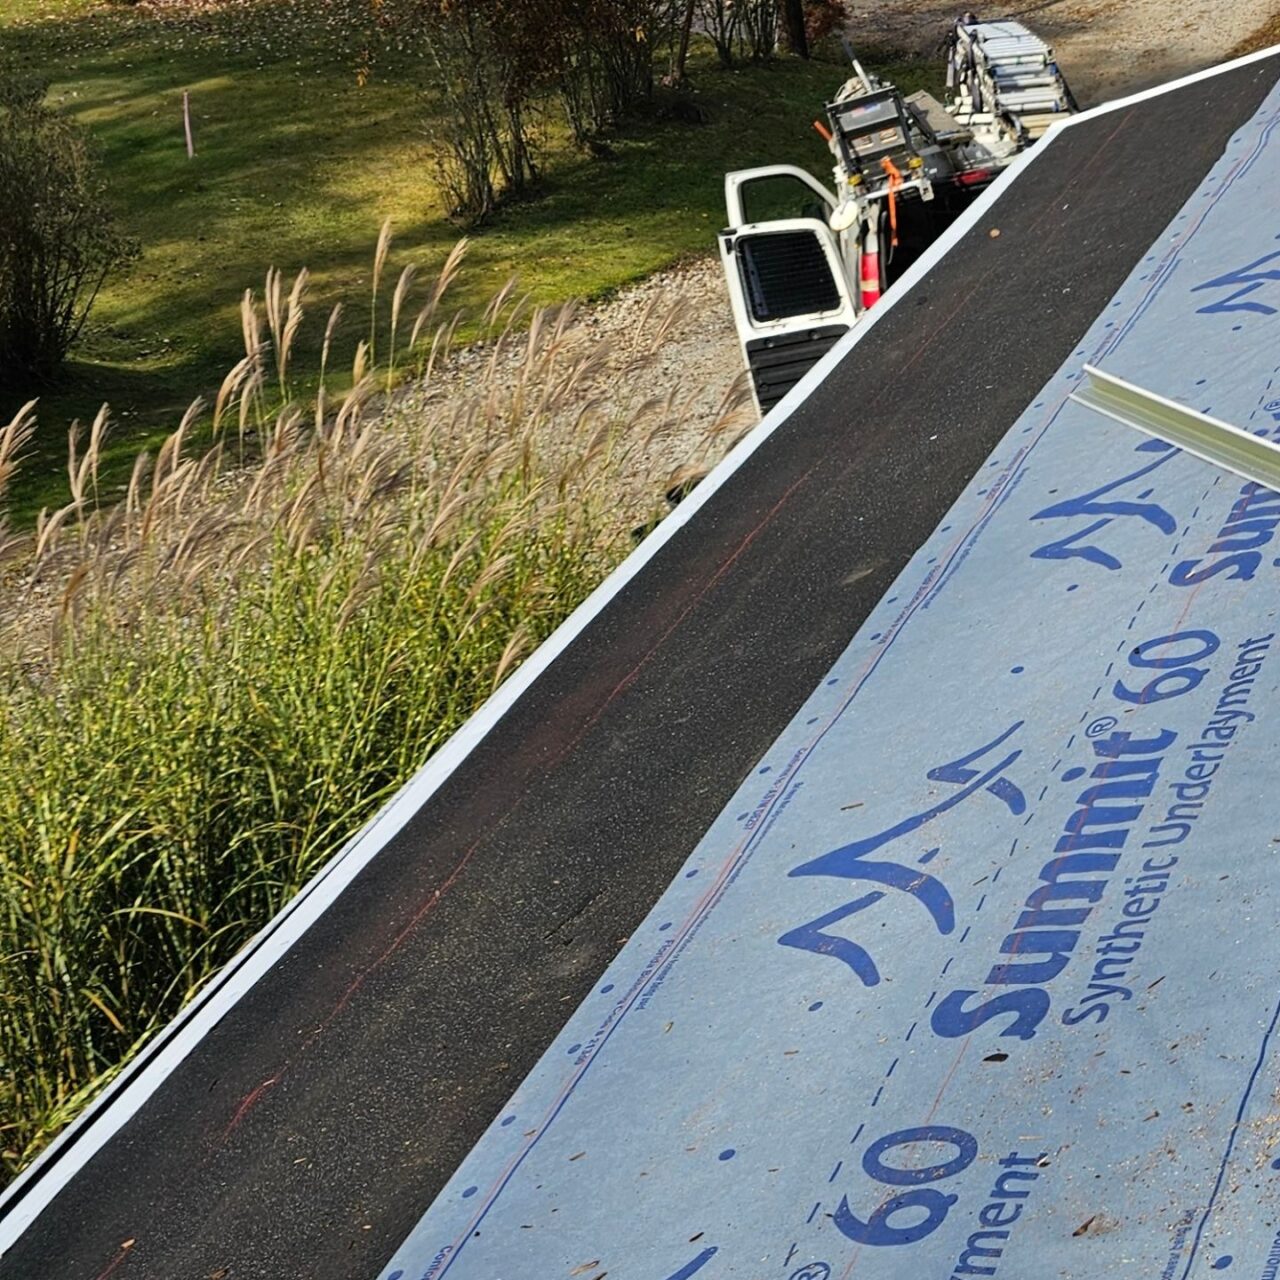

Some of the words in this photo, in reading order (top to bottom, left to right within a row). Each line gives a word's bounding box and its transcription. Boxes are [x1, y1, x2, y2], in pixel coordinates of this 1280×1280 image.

[1112, 629, 1221, 705] 60
[1062, 845, 1178, 1026] Synthetic
[1142, 632, 1275, 850] Underlayment
[833, 1124, 979, 1248] 60
